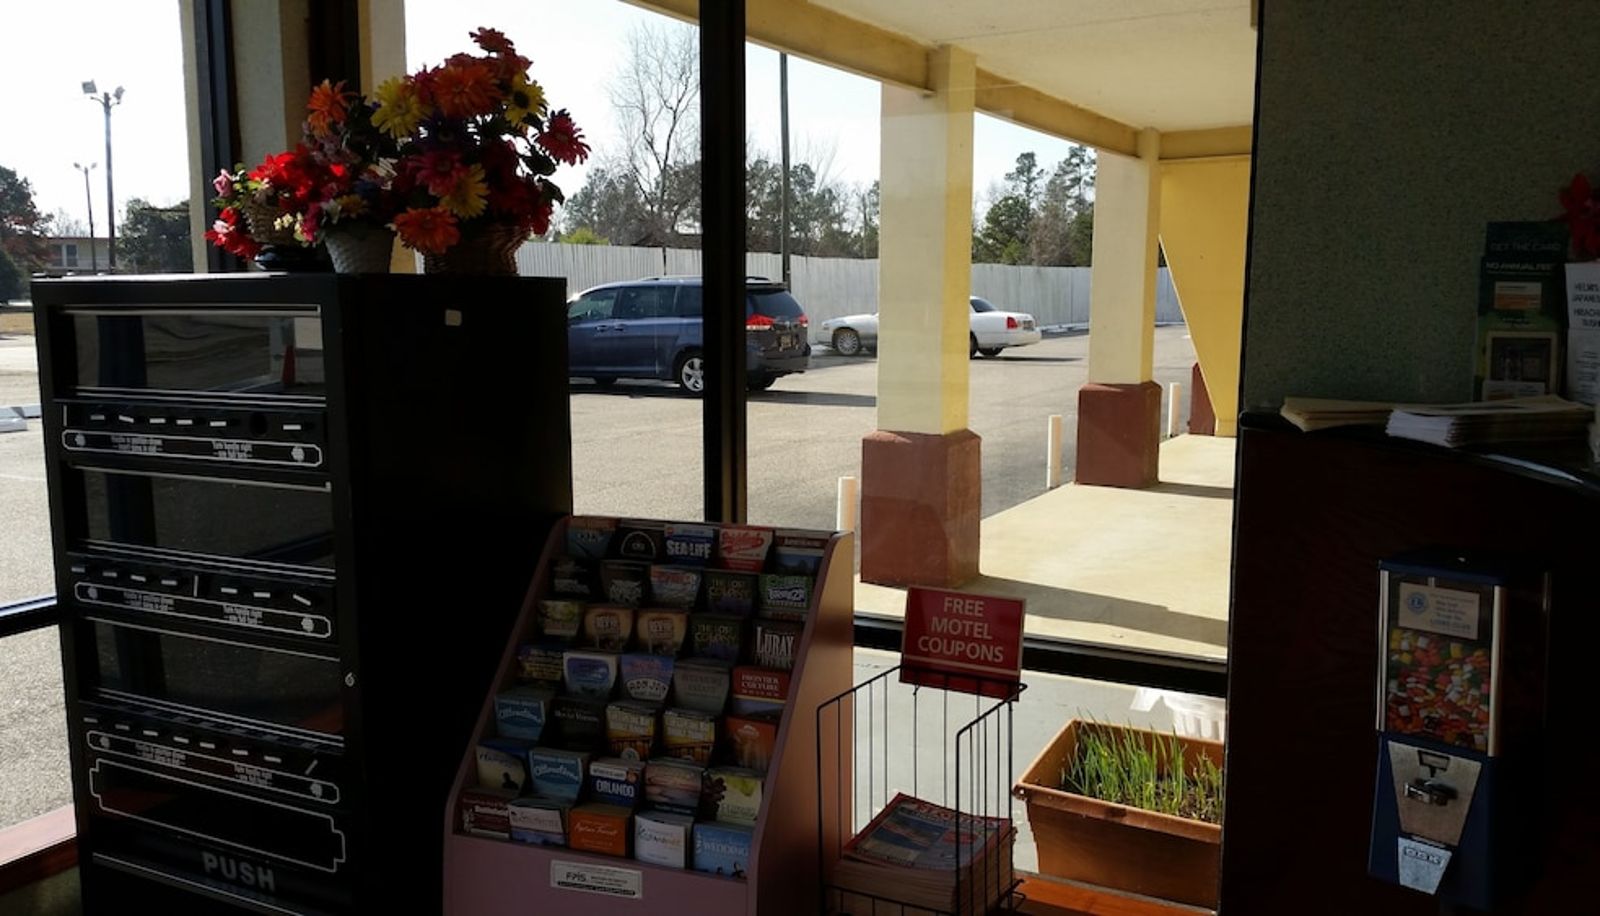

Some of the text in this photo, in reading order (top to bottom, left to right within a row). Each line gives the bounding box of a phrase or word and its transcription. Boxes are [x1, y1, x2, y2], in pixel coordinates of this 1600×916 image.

[667, 540, 689, 556] SEA
[690, 542, 711, 559] LIFE
[944, 598, 984, 616] FREE
[931, 617, 992, 639] MOTEL
[756, 626, 794, 657] LURAY
[917, 636, 1004, 663] COUPONS
[596, 779, 635, 798] ORLANDO
[202, 851, 275, 892] PUSH
